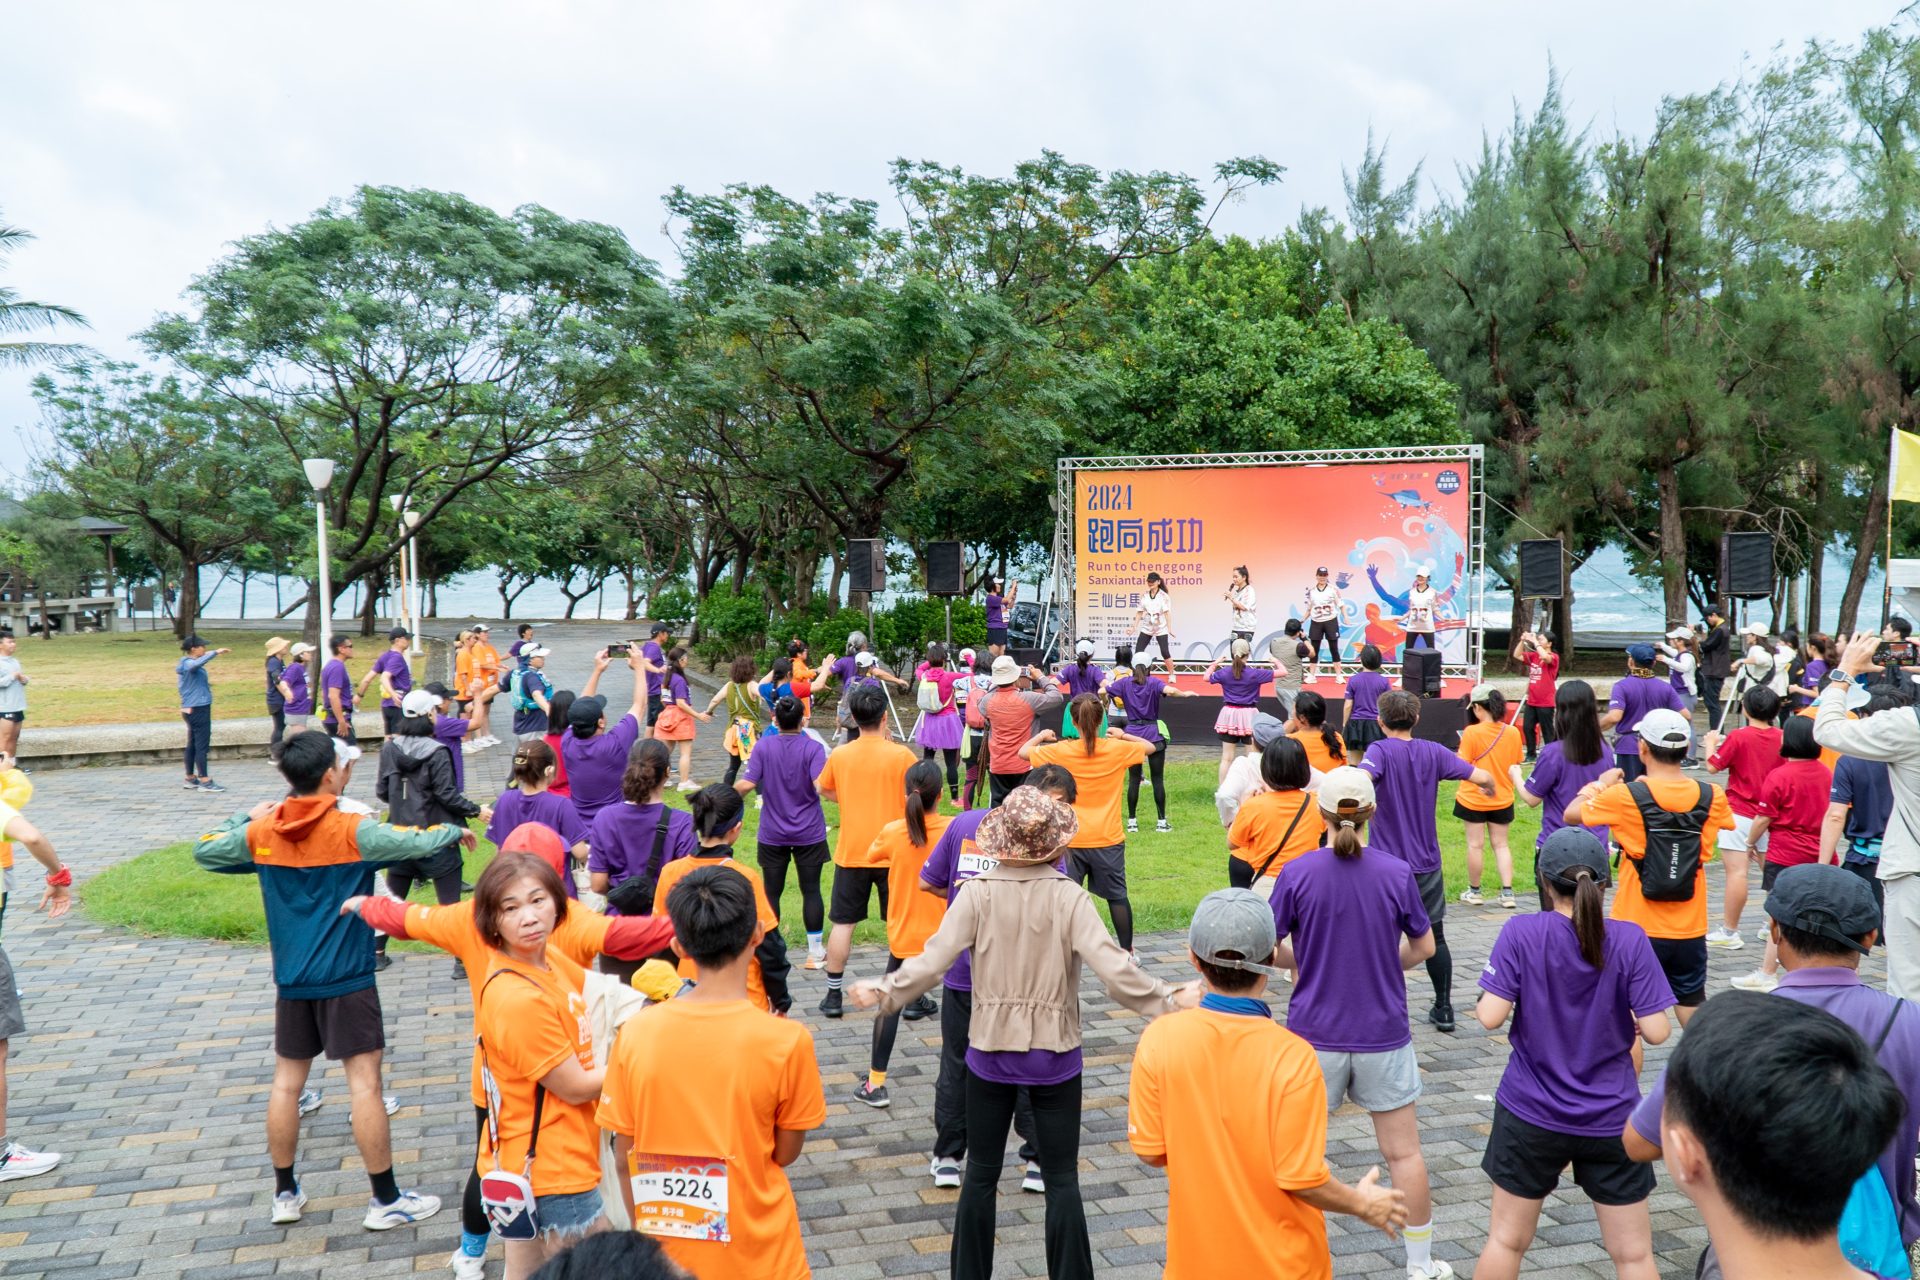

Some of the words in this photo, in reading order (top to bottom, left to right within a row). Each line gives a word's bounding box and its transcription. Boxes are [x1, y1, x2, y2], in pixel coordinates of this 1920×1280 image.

[1088, 484, 1132, 511] 2024
[1088, 518, 1203, 553] 跑向成功
[1088, 561, 1111, 571] Run
[1115, 562, 1127, 571] to
[1131, 561, 1203, 574] Chenggong
[1088, 575, 1147, 585] Sanxiantai
[1669, 866, 1677, 879] LAB
[662, 1178, 712, 1199] 5226
